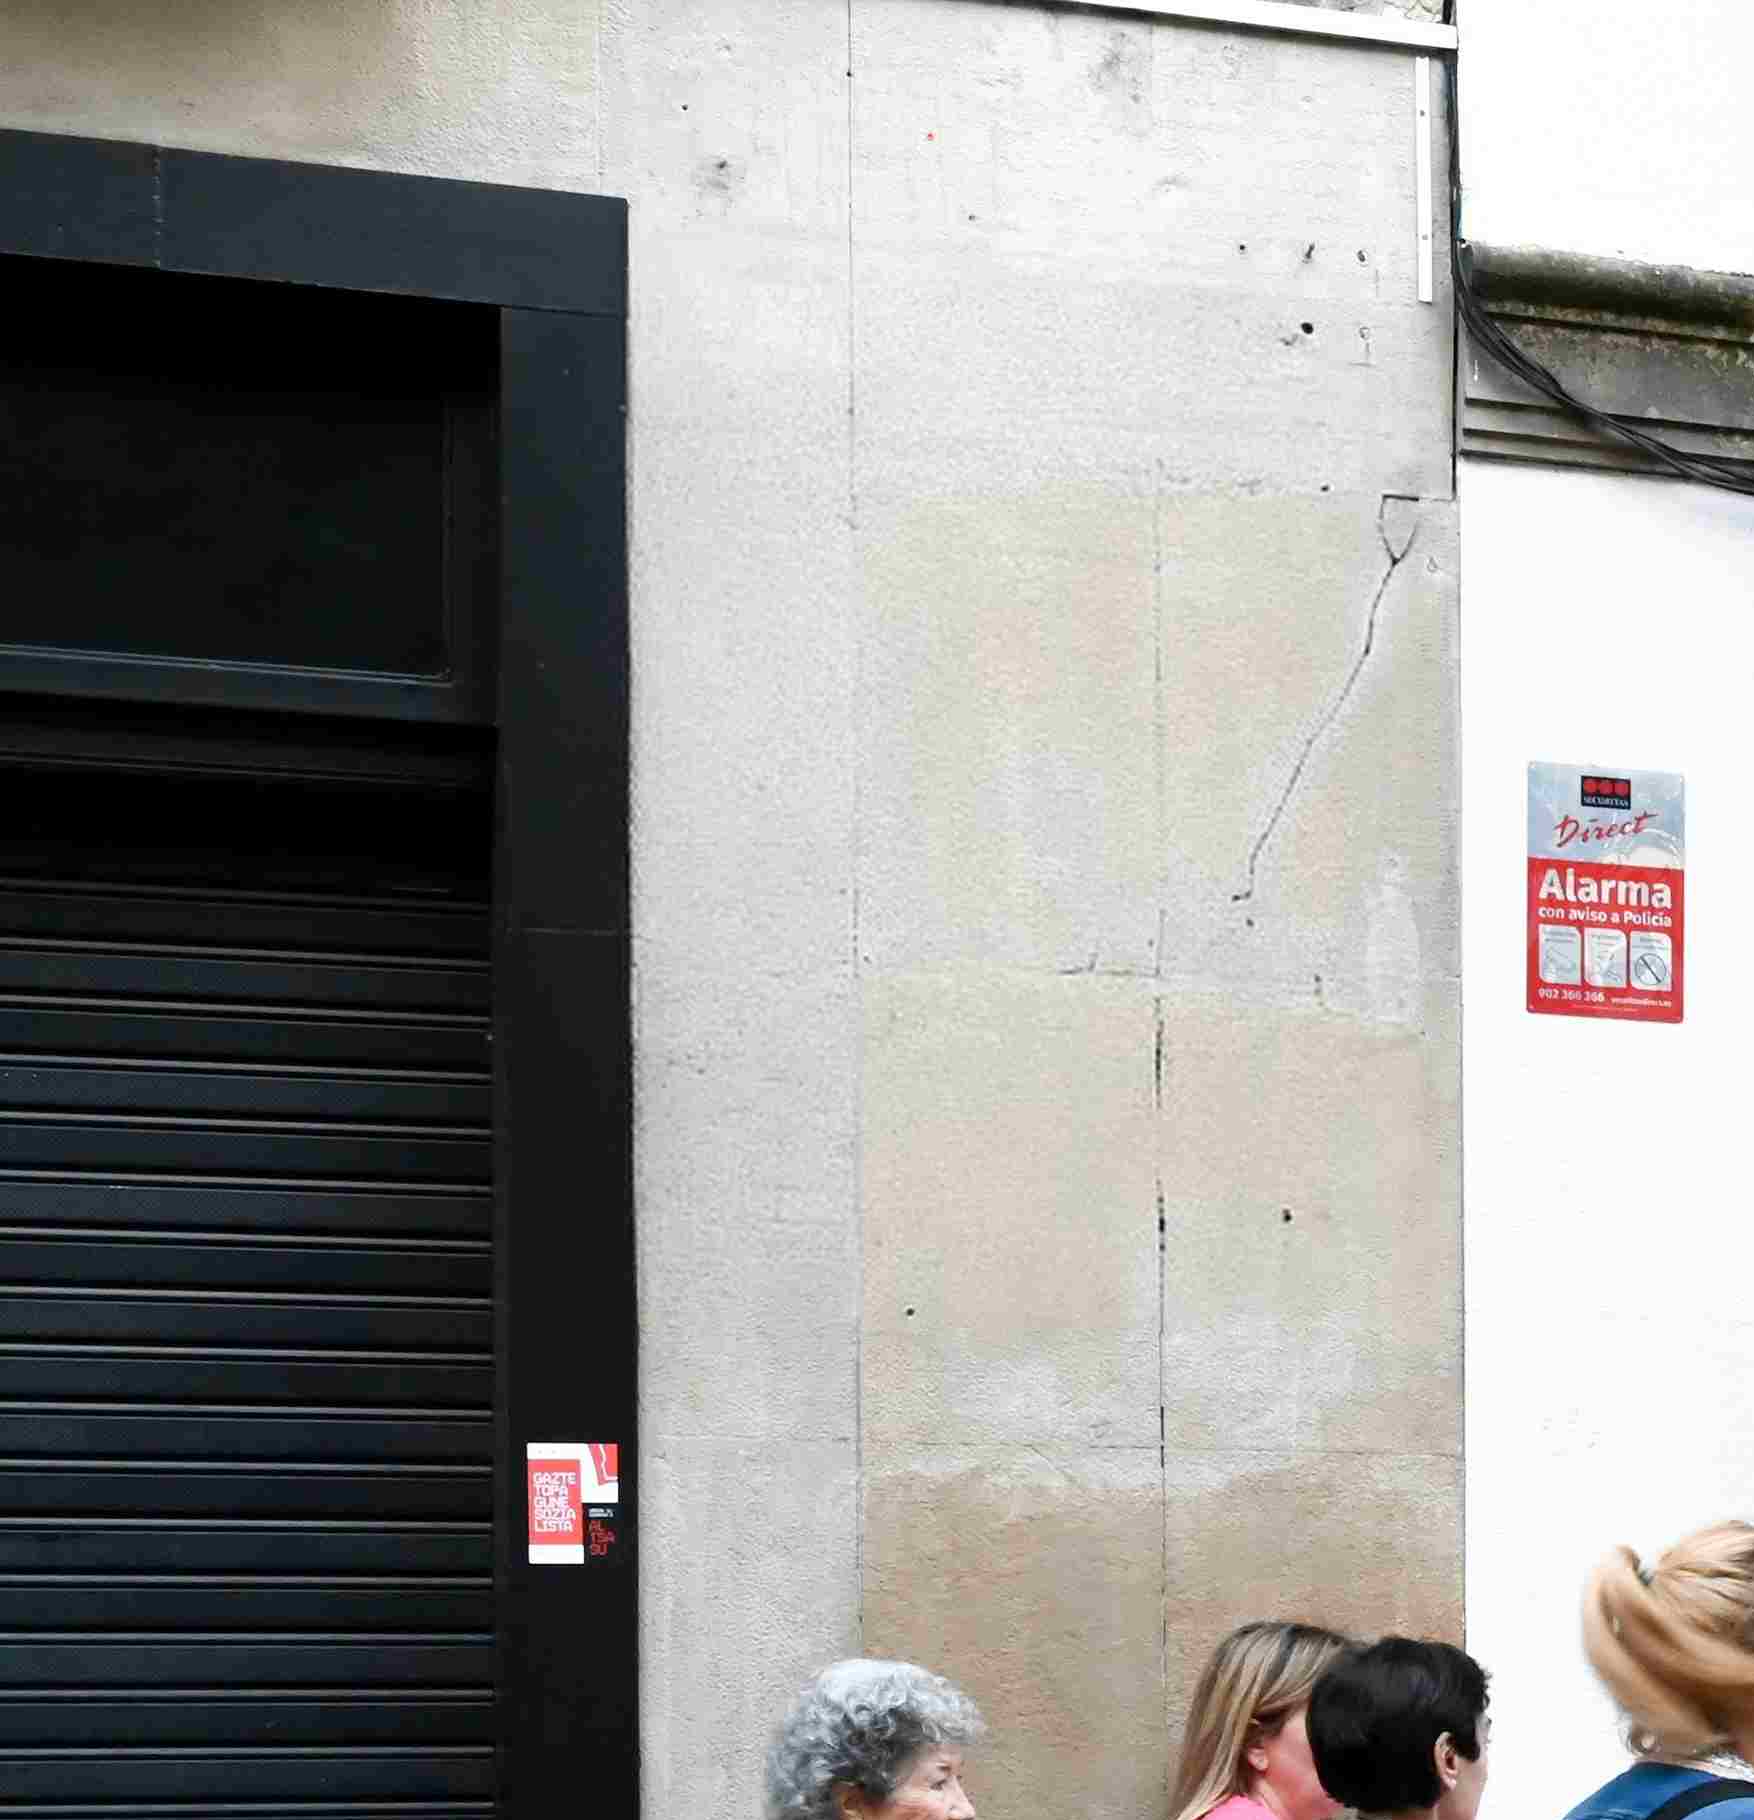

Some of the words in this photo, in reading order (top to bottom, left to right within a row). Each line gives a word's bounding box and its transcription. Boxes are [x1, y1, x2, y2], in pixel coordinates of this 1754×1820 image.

[1554, 812, 1658, 848] Direct
[1538, 867, 1672, 909] Alarma
[1538, 906, 1566, 919] con
[1568, 906, 1607, 922] aviso
[1611, 911, 1619, 923] a
